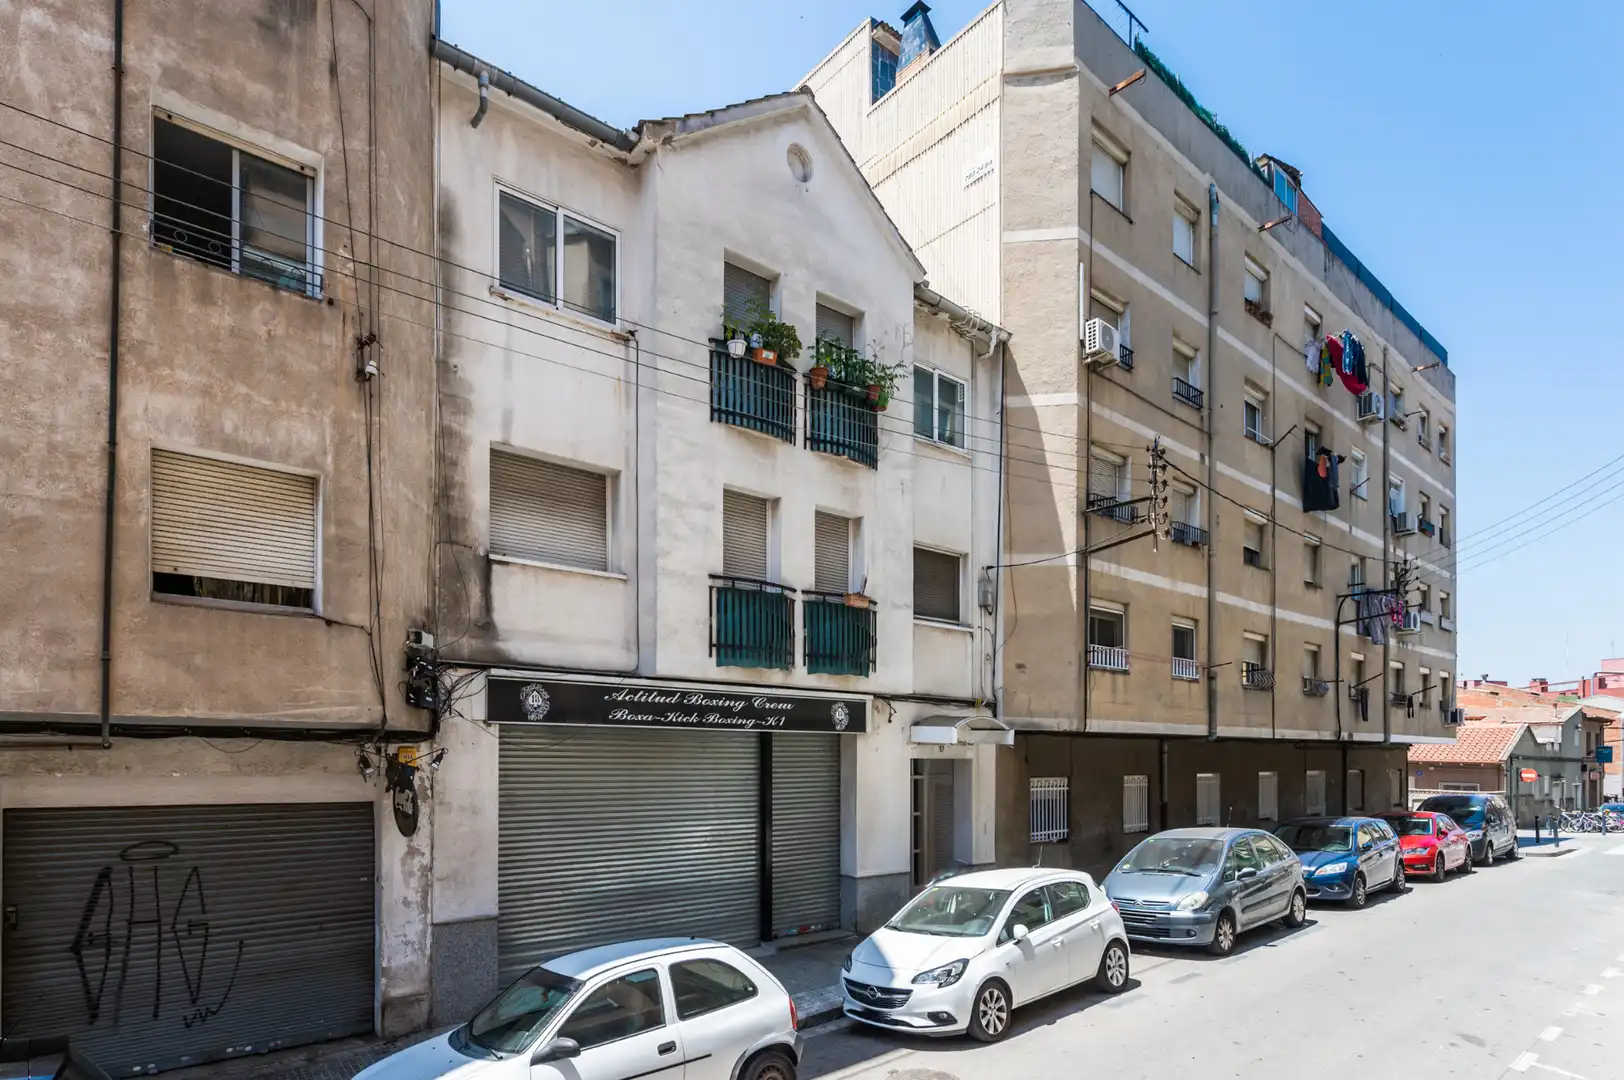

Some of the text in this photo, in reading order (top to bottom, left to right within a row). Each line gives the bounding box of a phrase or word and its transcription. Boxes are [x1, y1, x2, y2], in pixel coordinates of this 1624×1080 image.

[604, 688, 795, 712] Actitud Boxing Crew
[608, 708, 786, 729] Boxa-Kick Boxing-K1
